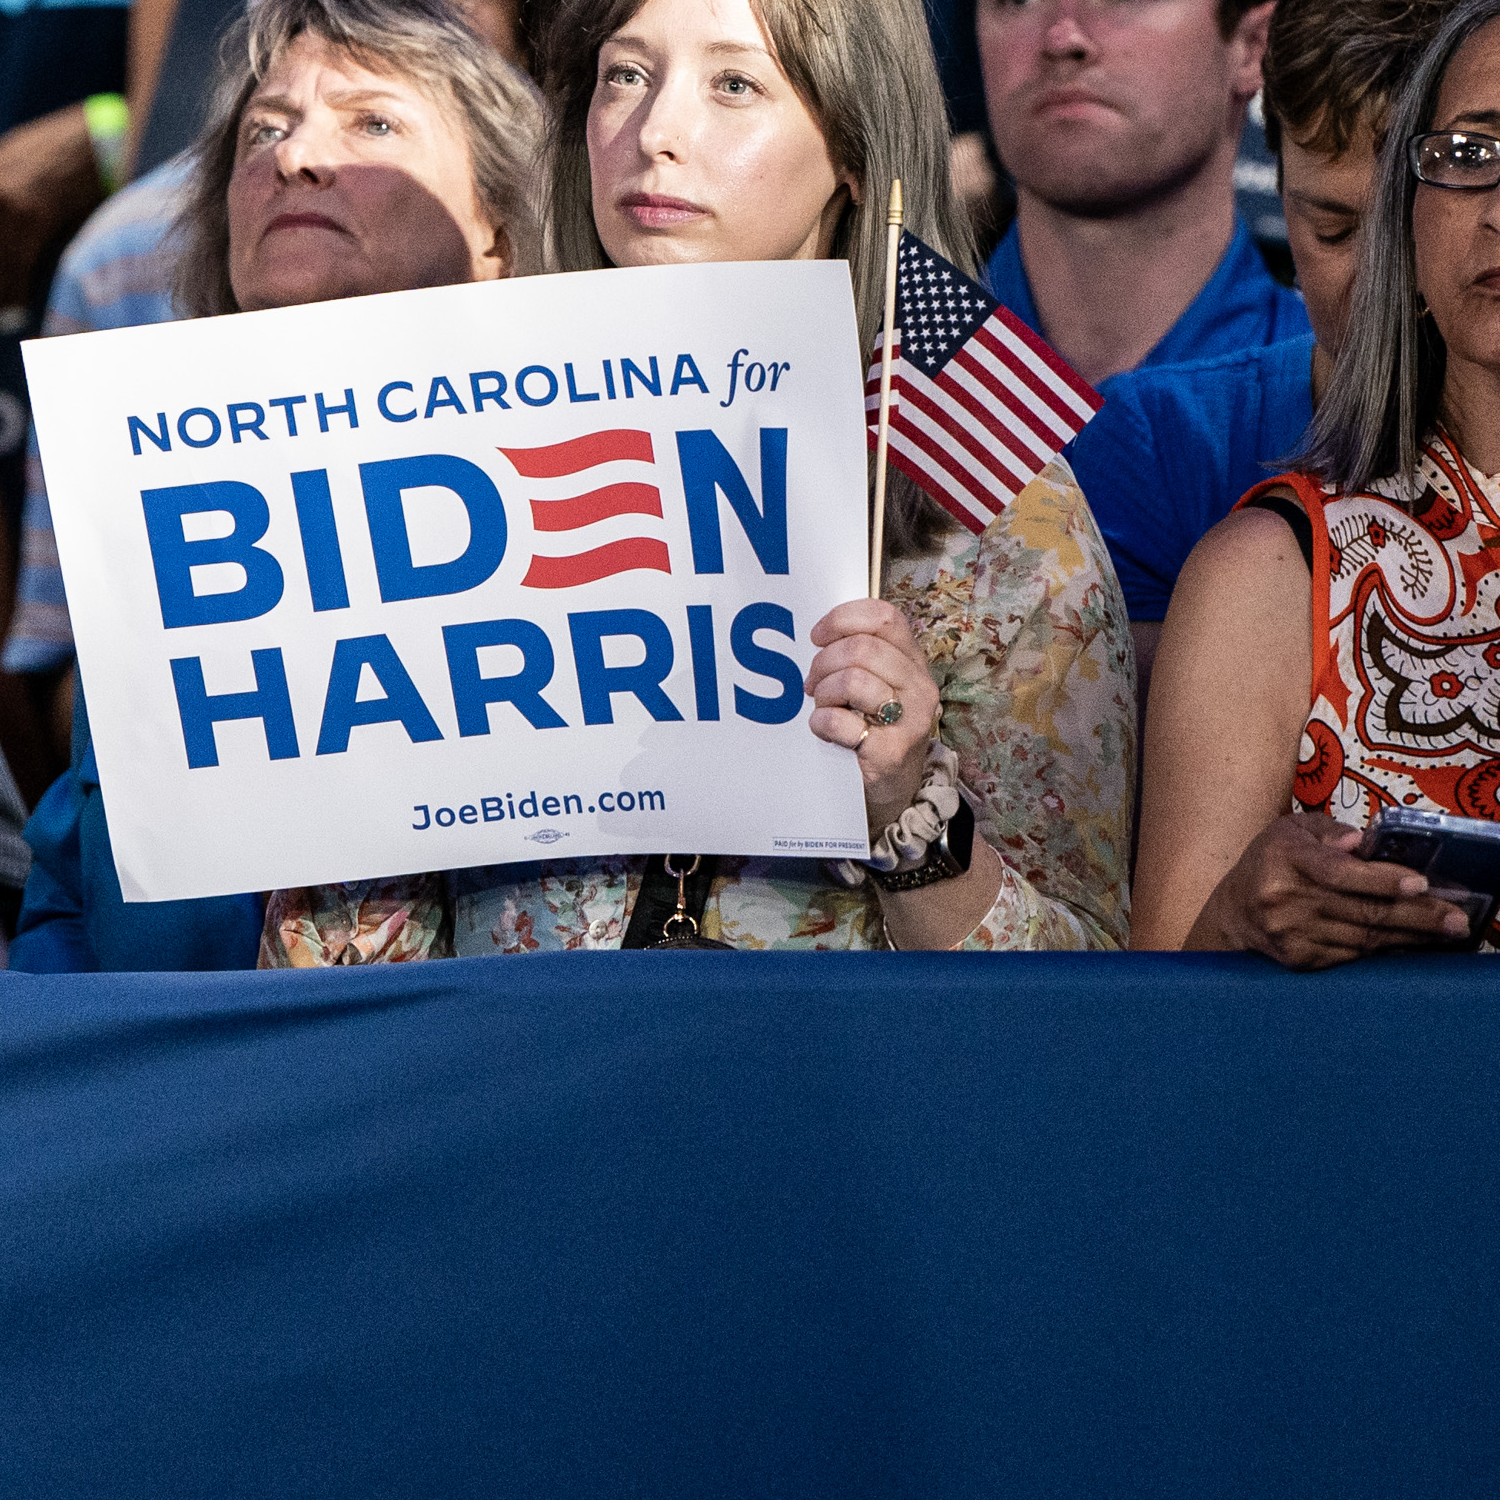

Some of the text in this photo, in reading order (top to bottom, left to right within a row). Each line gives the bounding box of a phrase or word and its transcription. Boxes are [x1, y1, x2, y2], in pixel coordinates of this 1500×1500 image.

[127, 348, 791, 456] NORTH CAROLINA for
[140, 426, 790, 630] BIDEN
[169, 601, 805, 770] HARRIS
[412, 790, 666, 830] JoeBiden.com
